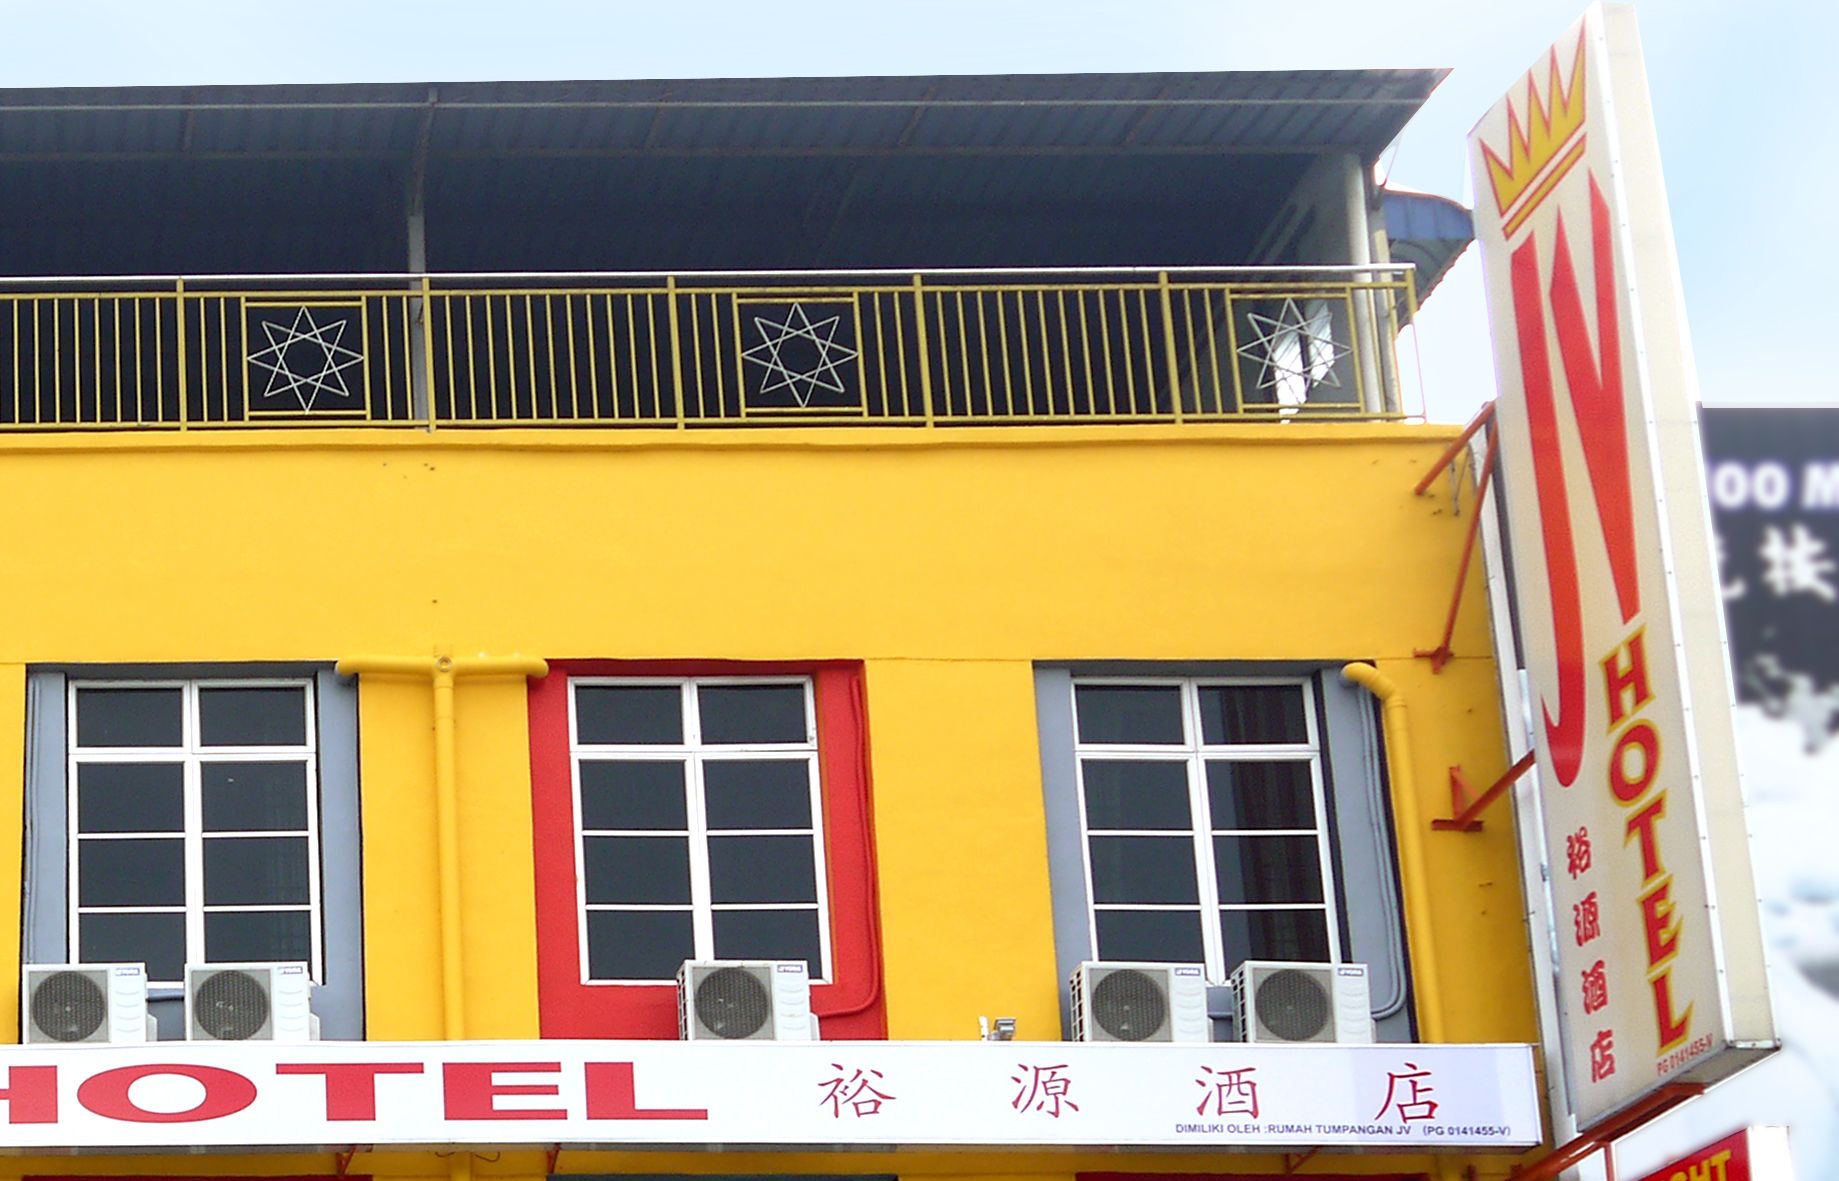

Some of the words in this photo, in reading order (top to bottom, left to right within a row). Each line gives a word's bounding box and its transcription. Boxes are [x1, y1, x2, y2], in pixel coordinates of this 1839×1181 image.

[1510, 166, 1642, 788] JV
[1598, 624, 1694, 1058] HOTEL
[1566, 825, 1616, 1084] 裕源酒店
[817, 1061, 1440, 1124] 裕源酒店
[1175, 1123, 1224, 1135] DIMILIKI
[1228, 1123, 1261, 1136] OLEH
[1316, 1124, 1393, 1136] TUMPANGAN
[1396, 1126, 1411, 1136] JV
[1657, 1058, 1669, 1076] PG
